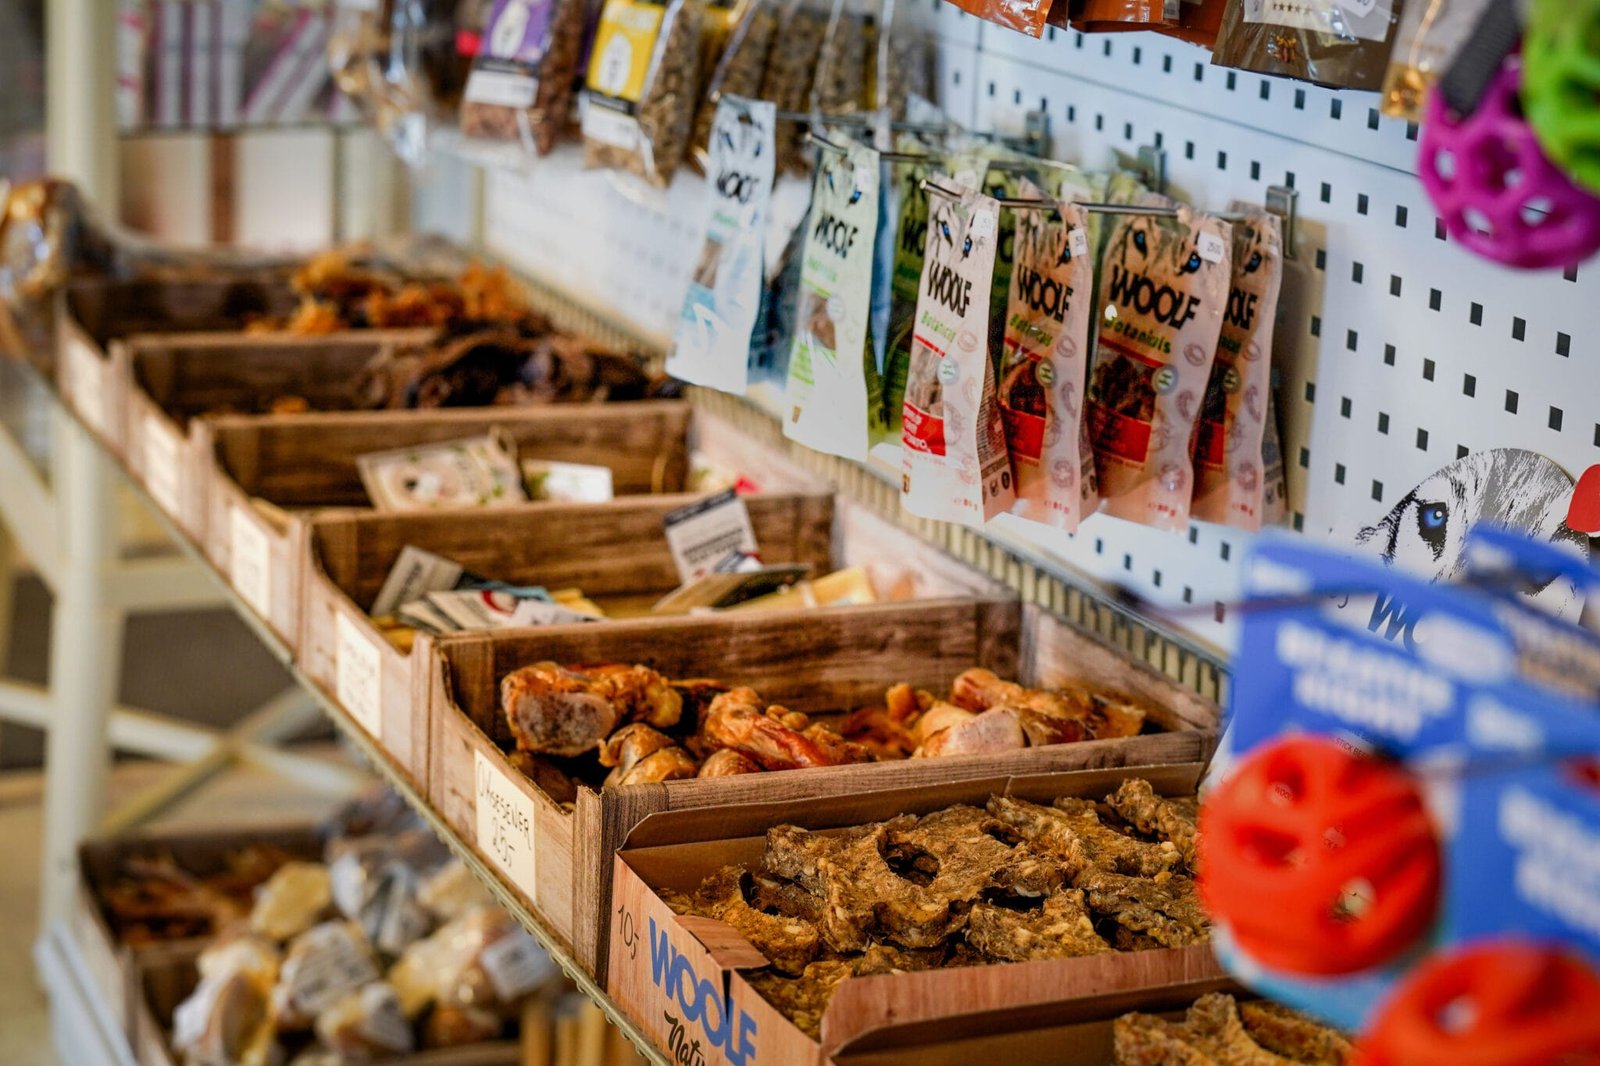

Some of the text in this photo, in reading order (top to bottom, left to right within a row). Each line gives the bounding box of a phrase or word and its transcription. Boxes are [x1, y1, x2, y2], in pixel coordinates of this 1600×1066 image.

[927, 259, 973, 319] WOOLF
[1017, 263, 1075, 323] WOOLF
[1109, 265, 1201, 331] WOOLF
[1224, 288, 1258, 331] OLF
[649, 916, 757, 1066] WOOLF
